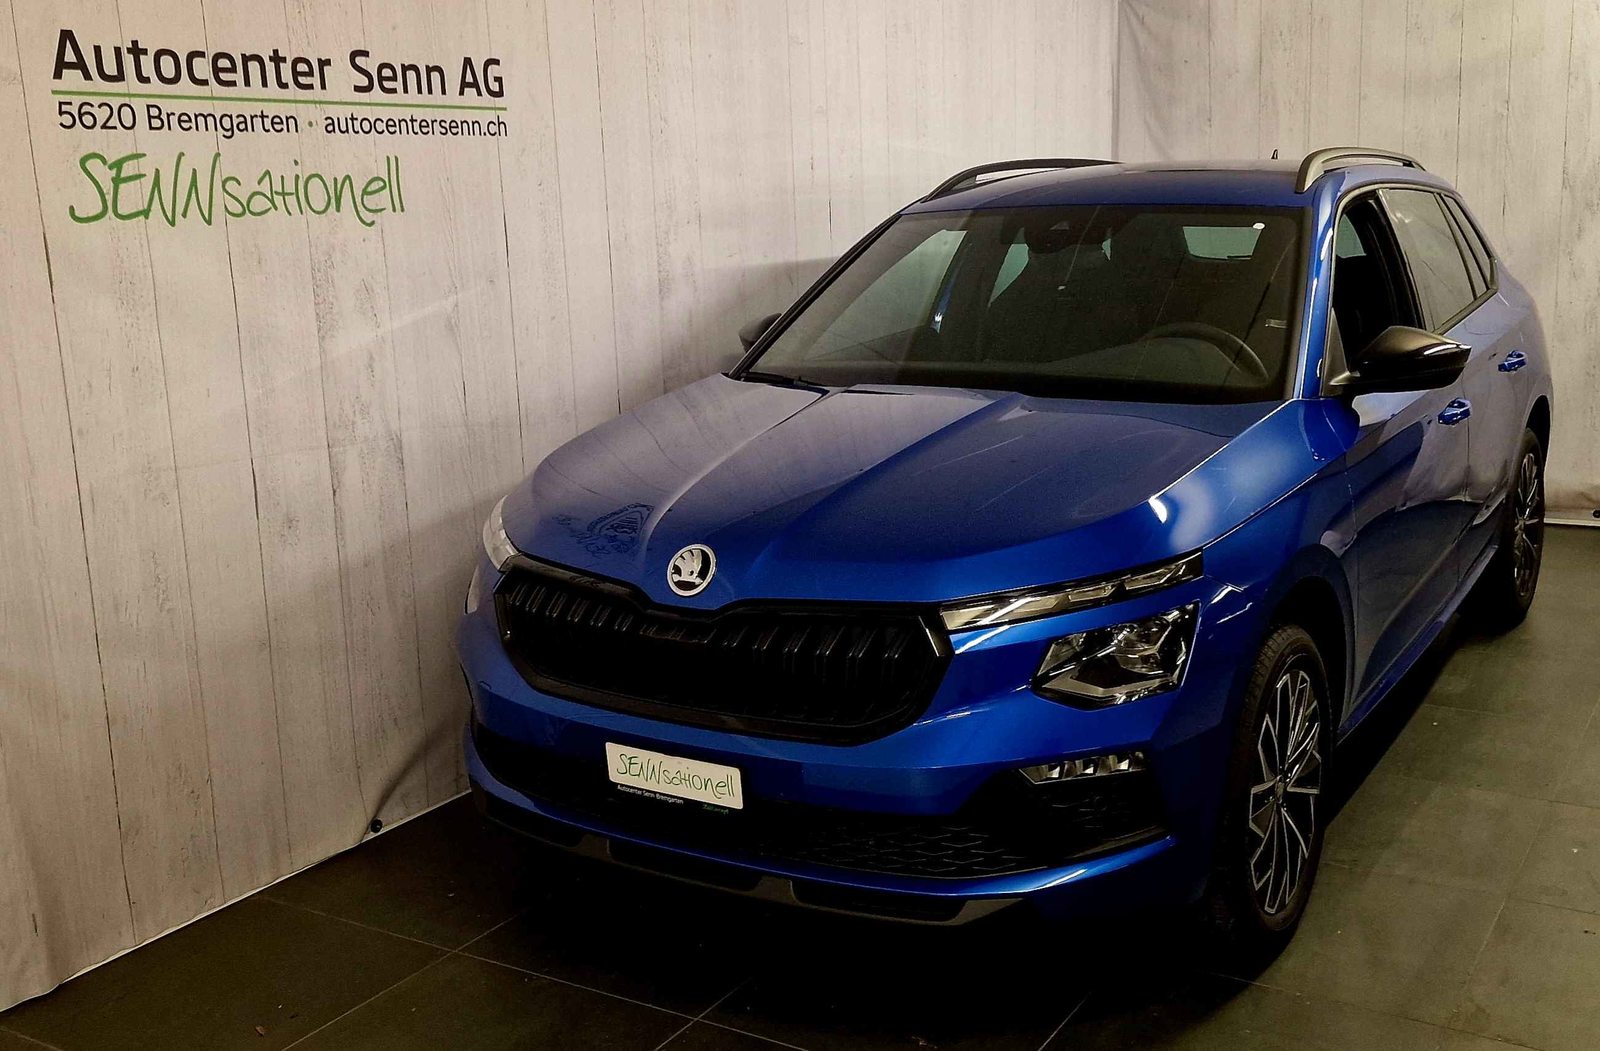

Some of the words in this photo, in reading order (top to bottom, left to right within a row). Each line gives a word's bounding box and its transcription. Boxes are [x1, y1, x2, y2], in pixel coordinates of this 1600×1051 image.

[52, 28, 332, 91] Autocenter
[348, 49, 447, 96] Senn
[458, 56, 505, 98] AG
[57, 101, 137, 132] 5620
[146, 103, 299, 139] Bremgarten
[323, 111, 508, 137] autocentersenn.ch
[69, 151, 406, 227] SENNsationell
[616, 753, 735, 799] SENNsationell
[617, 784, 642, 796] Autocenter
[642, 790, 655, 799] Senn
[655, 793, 684, 805] Bremgarten
